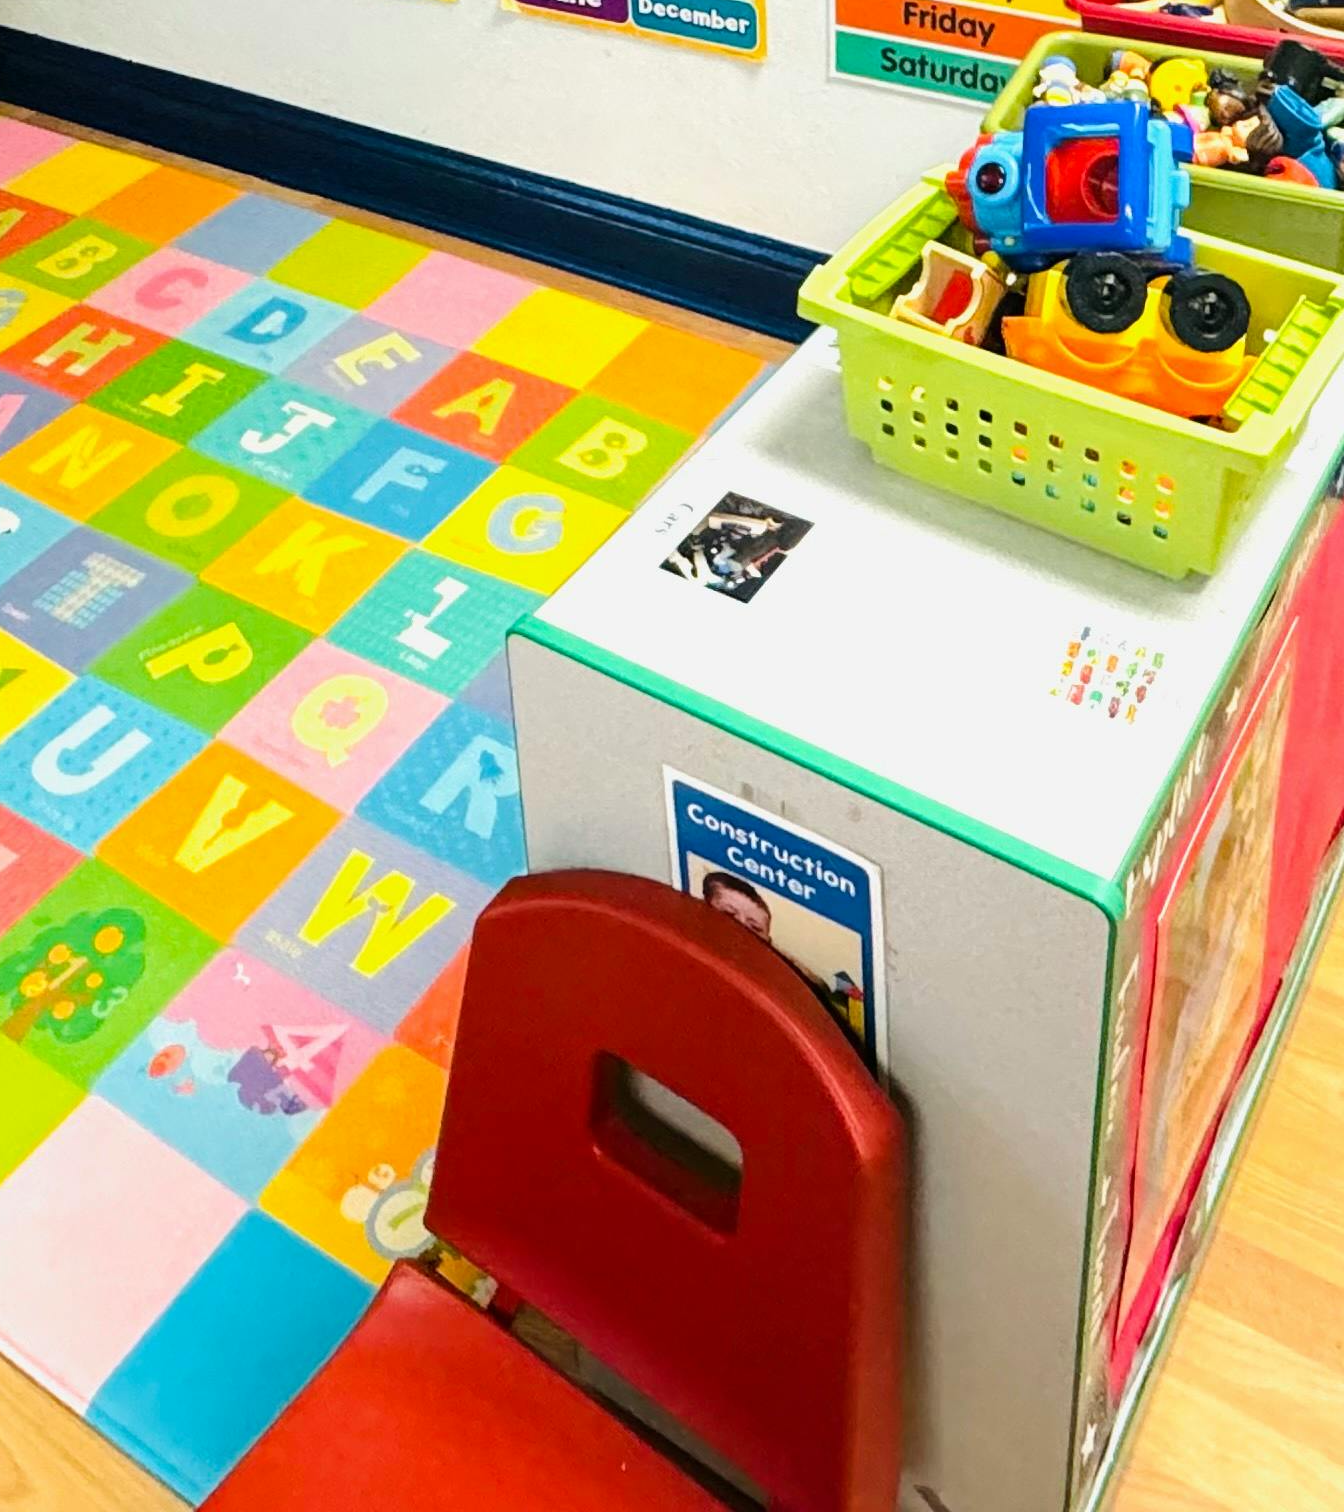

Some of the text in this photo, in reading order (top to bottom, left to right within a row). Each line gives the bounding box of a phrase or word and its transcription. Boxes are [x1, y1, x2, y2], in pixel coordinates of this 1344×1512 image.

[902, 1, 995, 47] Friday
[686, 802, 857, 899] Construction
[726, 845, 817, 902] Center
